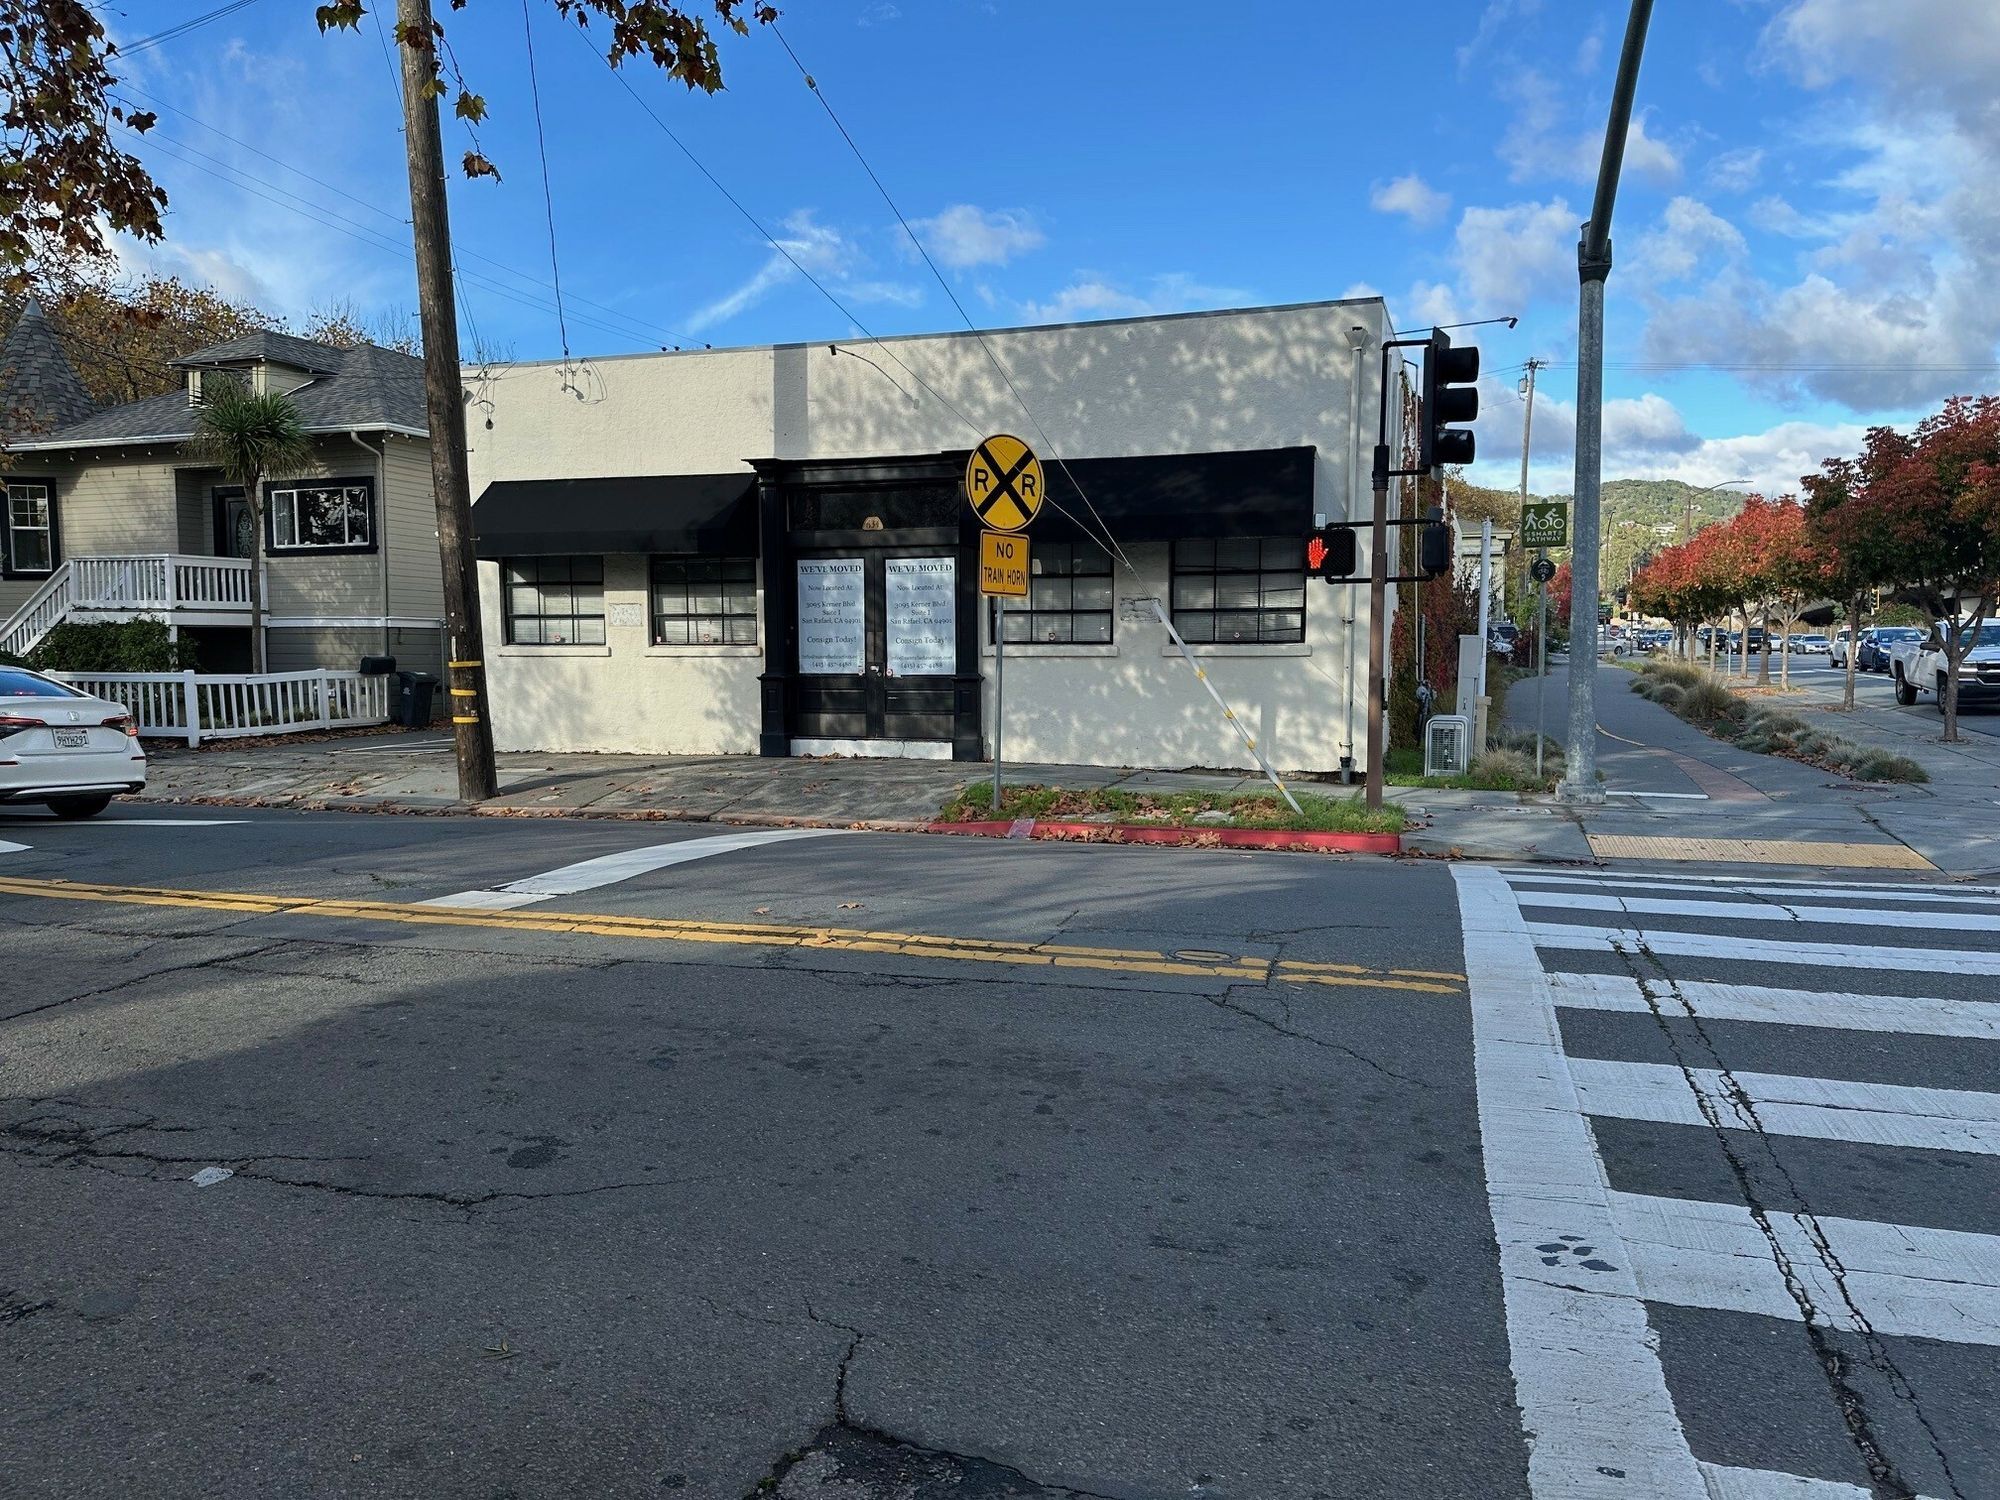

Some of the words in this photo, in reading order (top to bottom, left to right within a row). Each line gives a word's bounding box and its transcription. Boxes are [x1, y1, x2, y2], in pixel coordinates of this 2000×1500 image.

[974, 468, 989, 493] R
[1021, 473, 1036, 497] R
[996, 542, 1014, 559] NO
[984, 566, 1004, 584] TRAIN
[1006, 570, 1026, 586] HORN
[806, 636, 833, 645] Consign
[834, 635, 857, 645] Today!
[895, 637, 922, 646] Consign
[57, 735, 88, 746] 9HYH291
